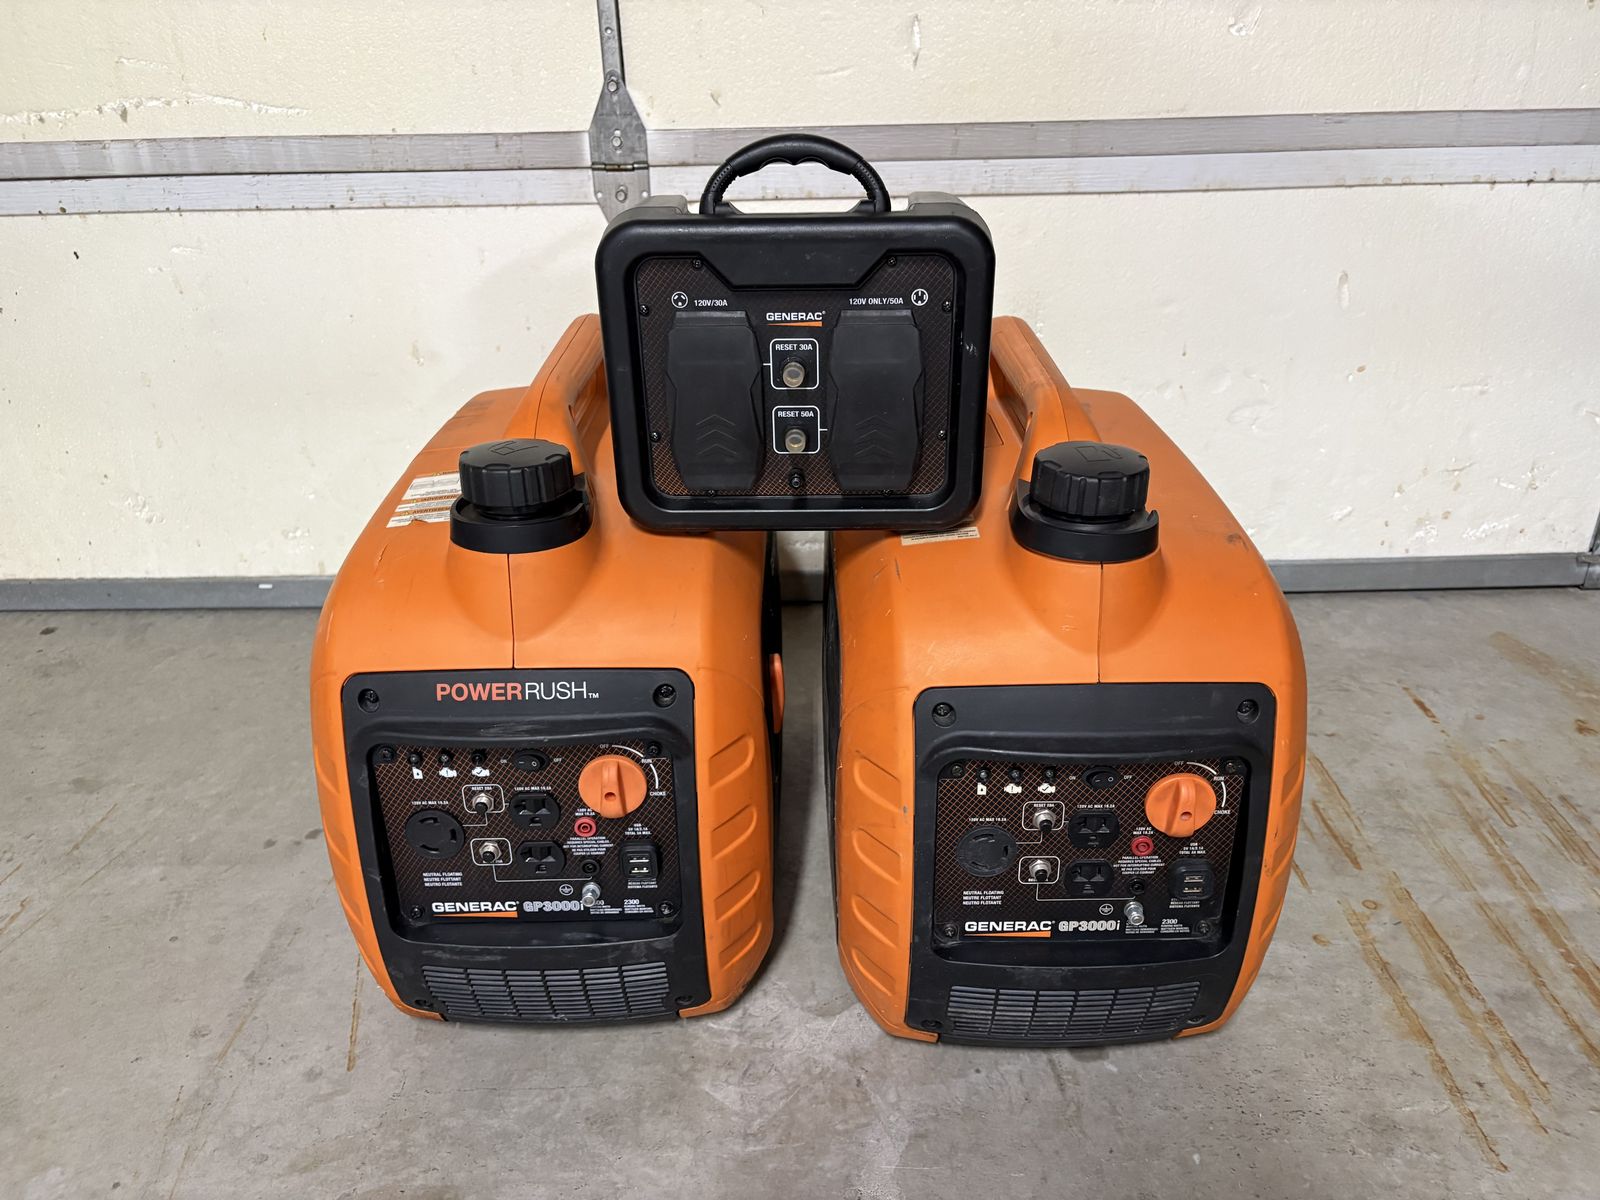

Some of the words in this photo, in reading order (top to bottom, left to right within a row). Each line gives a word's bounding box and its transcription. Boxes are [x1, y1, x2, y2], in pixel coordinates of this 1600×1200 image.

[694, 299, 728, 307] 120V/30A
[868, 297, 904, 305] ONLY/50A
[523, 900, 584, 912] GP3000i
[1058, 920, 1120, 931] GP3000i
